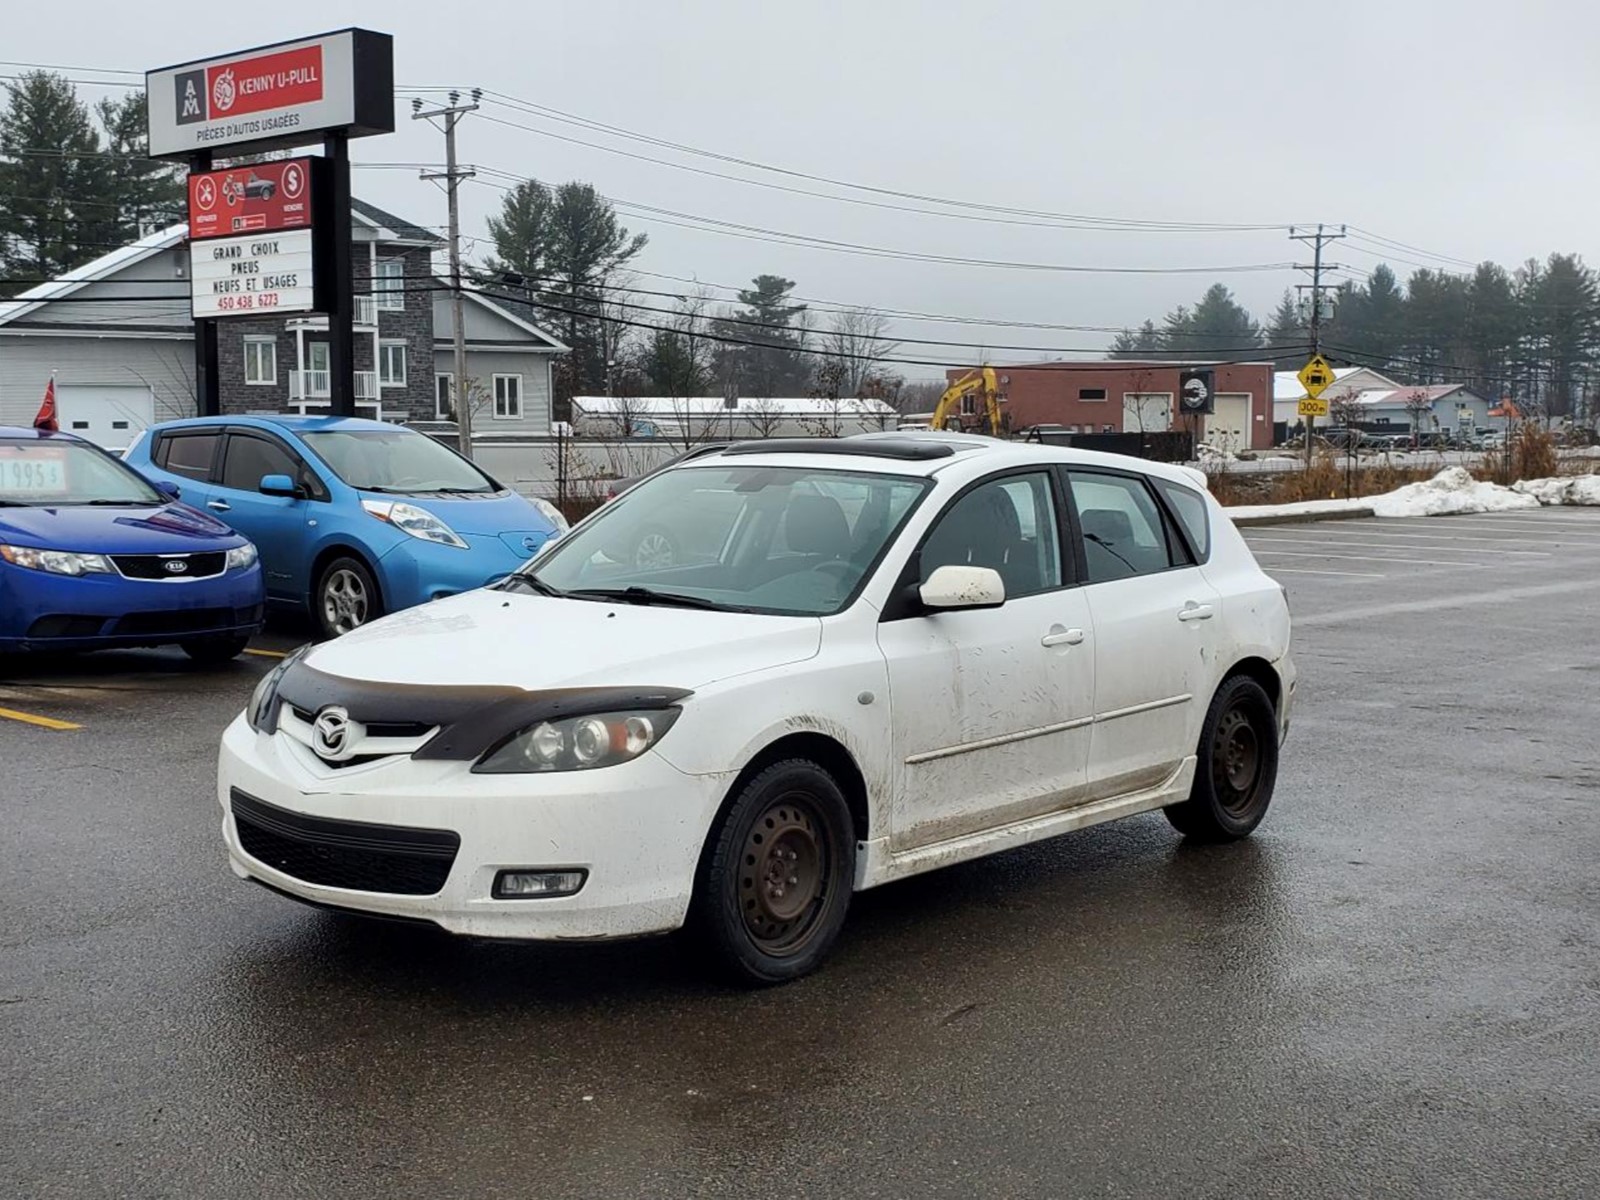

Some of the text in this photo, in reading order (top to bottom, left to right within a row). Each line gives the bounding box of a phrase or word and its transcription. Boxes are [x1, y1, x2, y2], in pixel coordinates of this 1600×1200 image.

[239, 66, 318, 96] KENNY U-PULL
[196, 112, 300, 142] PIÈCES D'AUTOS USAGÉES
[213, 241, 279, 260] GRAND CHOIX
[231, 260, 259, 275] PNEUS
[213, 274, 297, 294] NEUFS ET USAGES
[217, 292, 279, 309] 450 438 6273
[1300, 401, 1318, 412] 300
